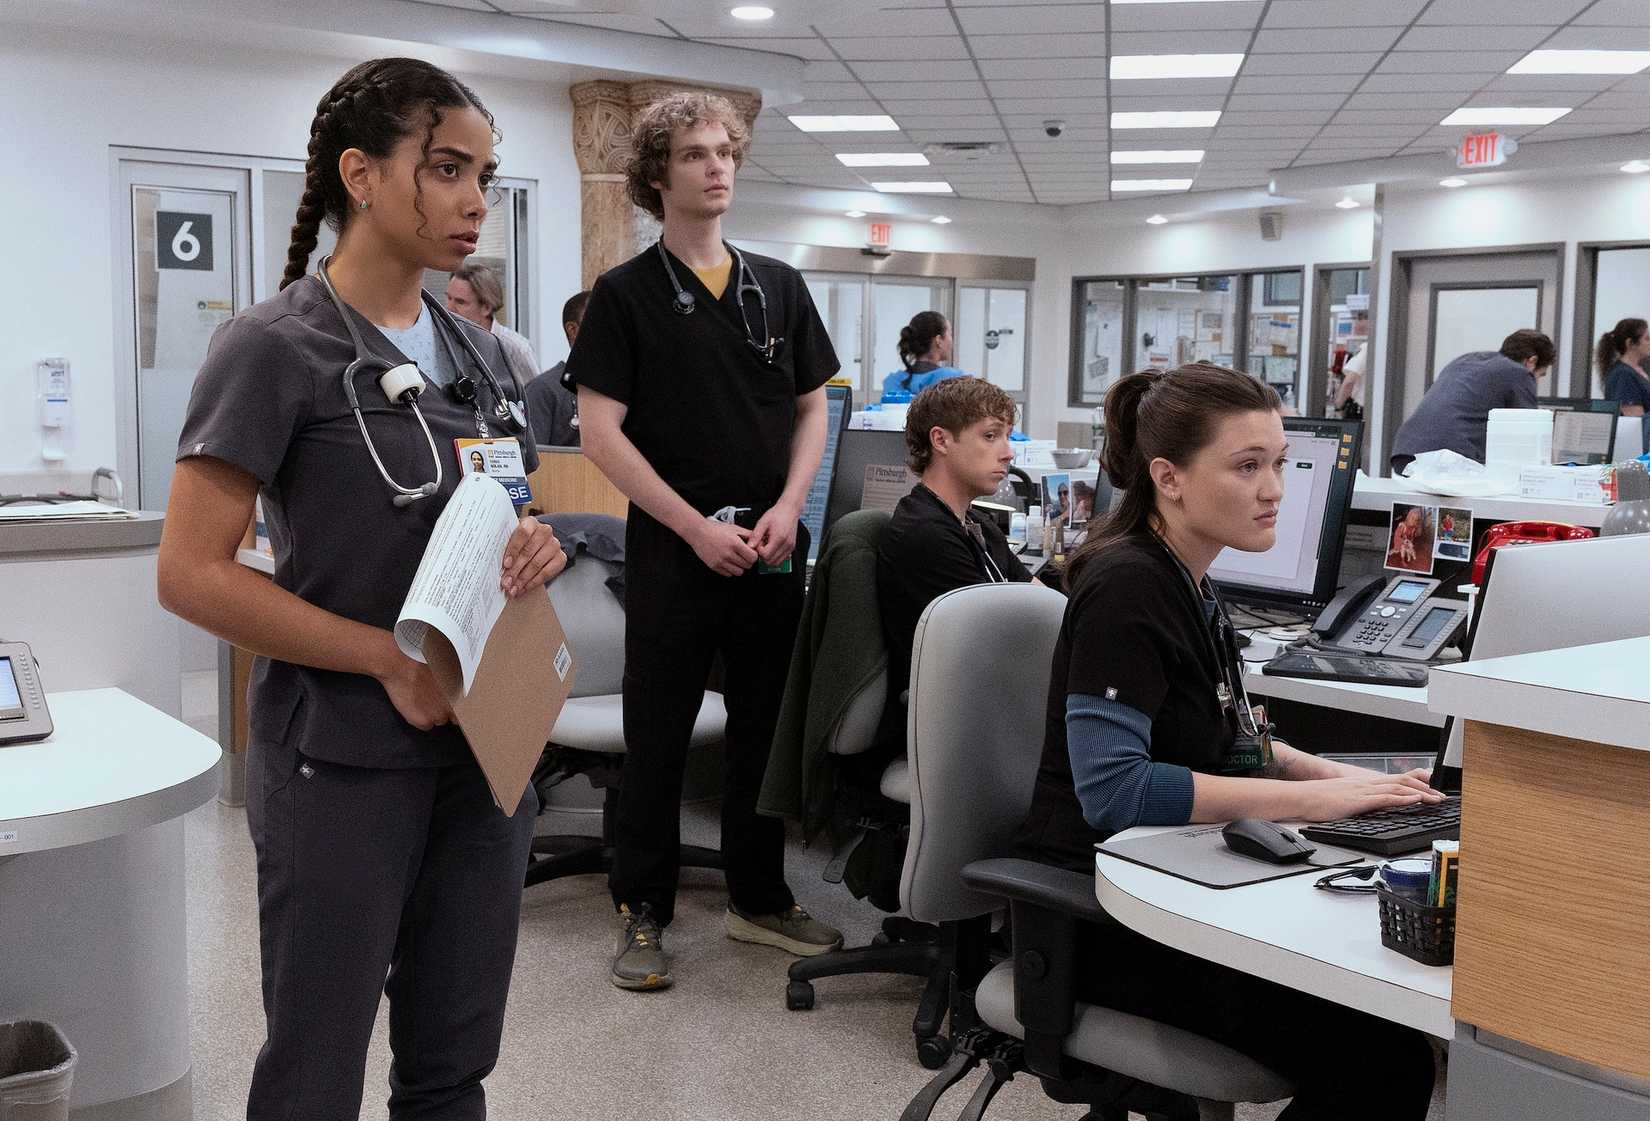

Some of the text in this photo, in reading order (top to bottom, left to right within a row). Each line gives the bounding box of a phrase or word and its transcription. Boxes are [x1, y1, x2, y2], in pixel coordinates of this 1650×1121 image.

[1464, 133, 1499, 164] EXIT
[172, 221, 200, 261] 6
[871, 224, 890, 243] EXIT
